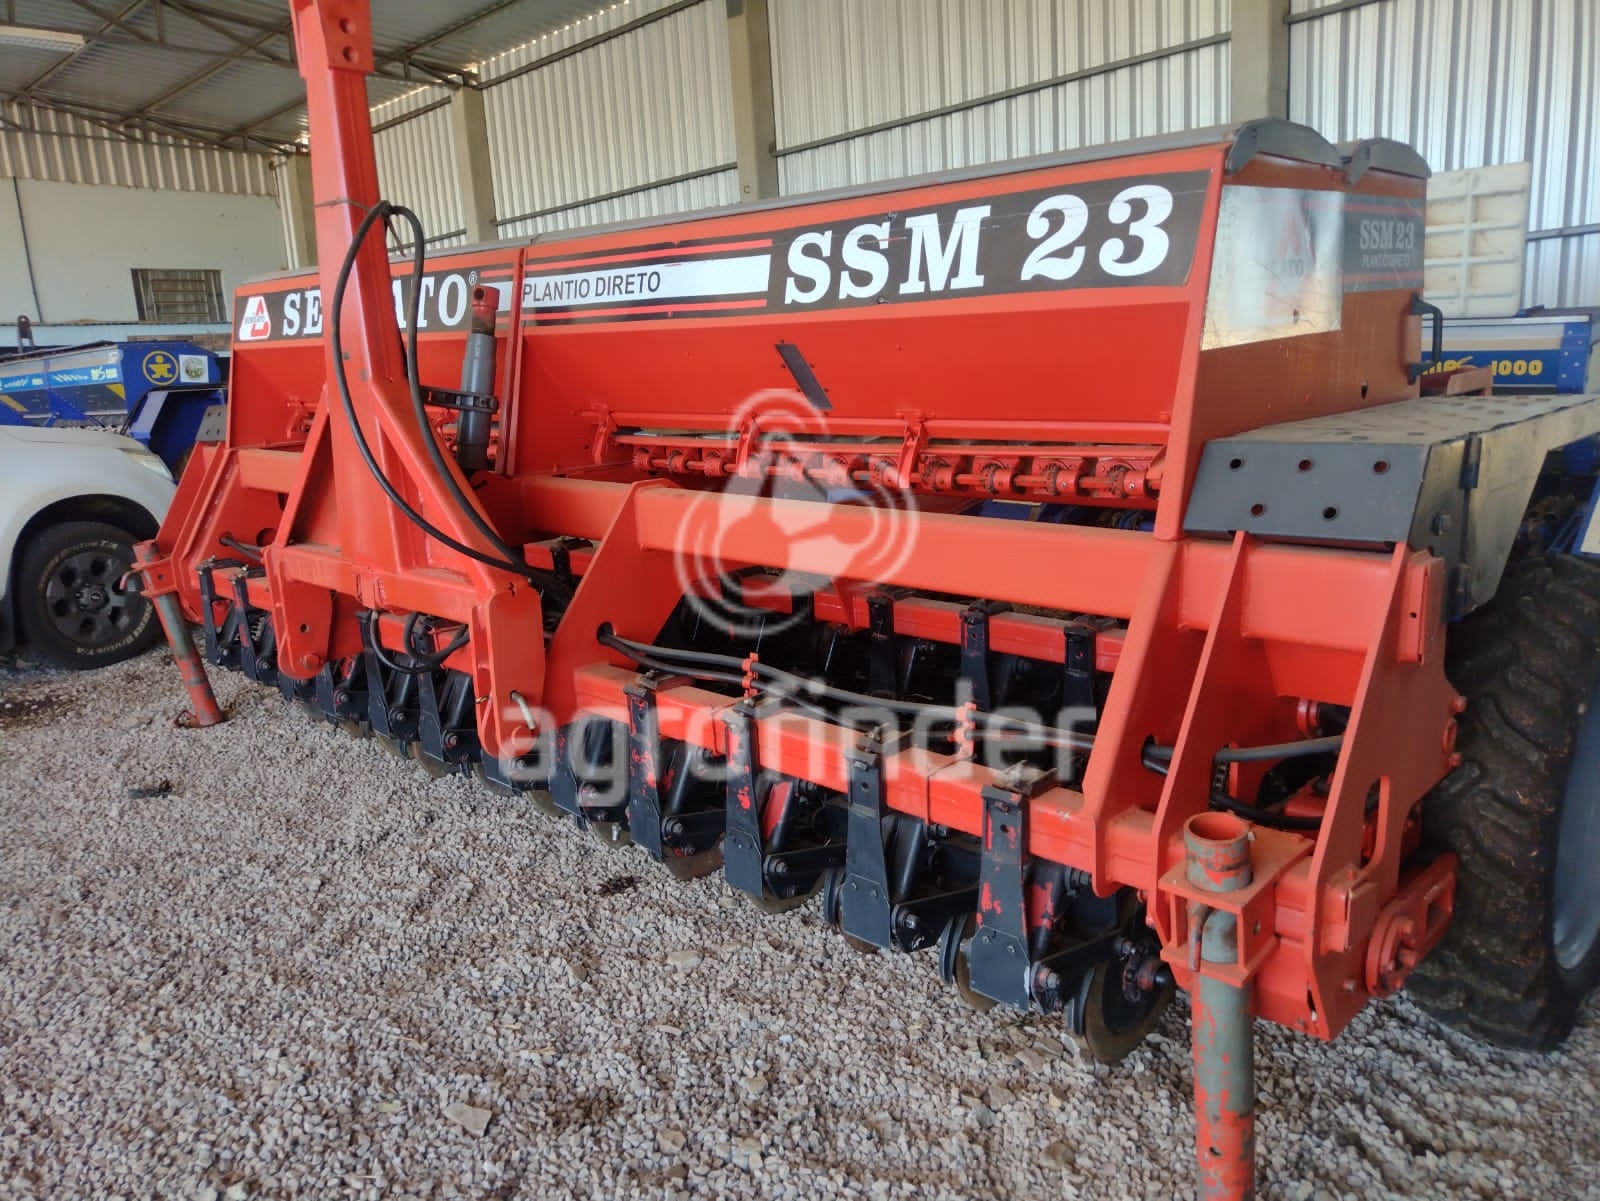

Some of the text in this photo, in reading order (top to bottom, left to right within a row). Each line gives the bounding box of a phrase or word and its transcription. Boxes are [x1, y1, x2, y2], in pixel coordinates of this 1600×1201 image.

[784, 184, 1174, 305] SSM 23
[1359, 219, 1415, 250] SSM 23
[522, 271, 661, 303] PLANTIO DIRETO
